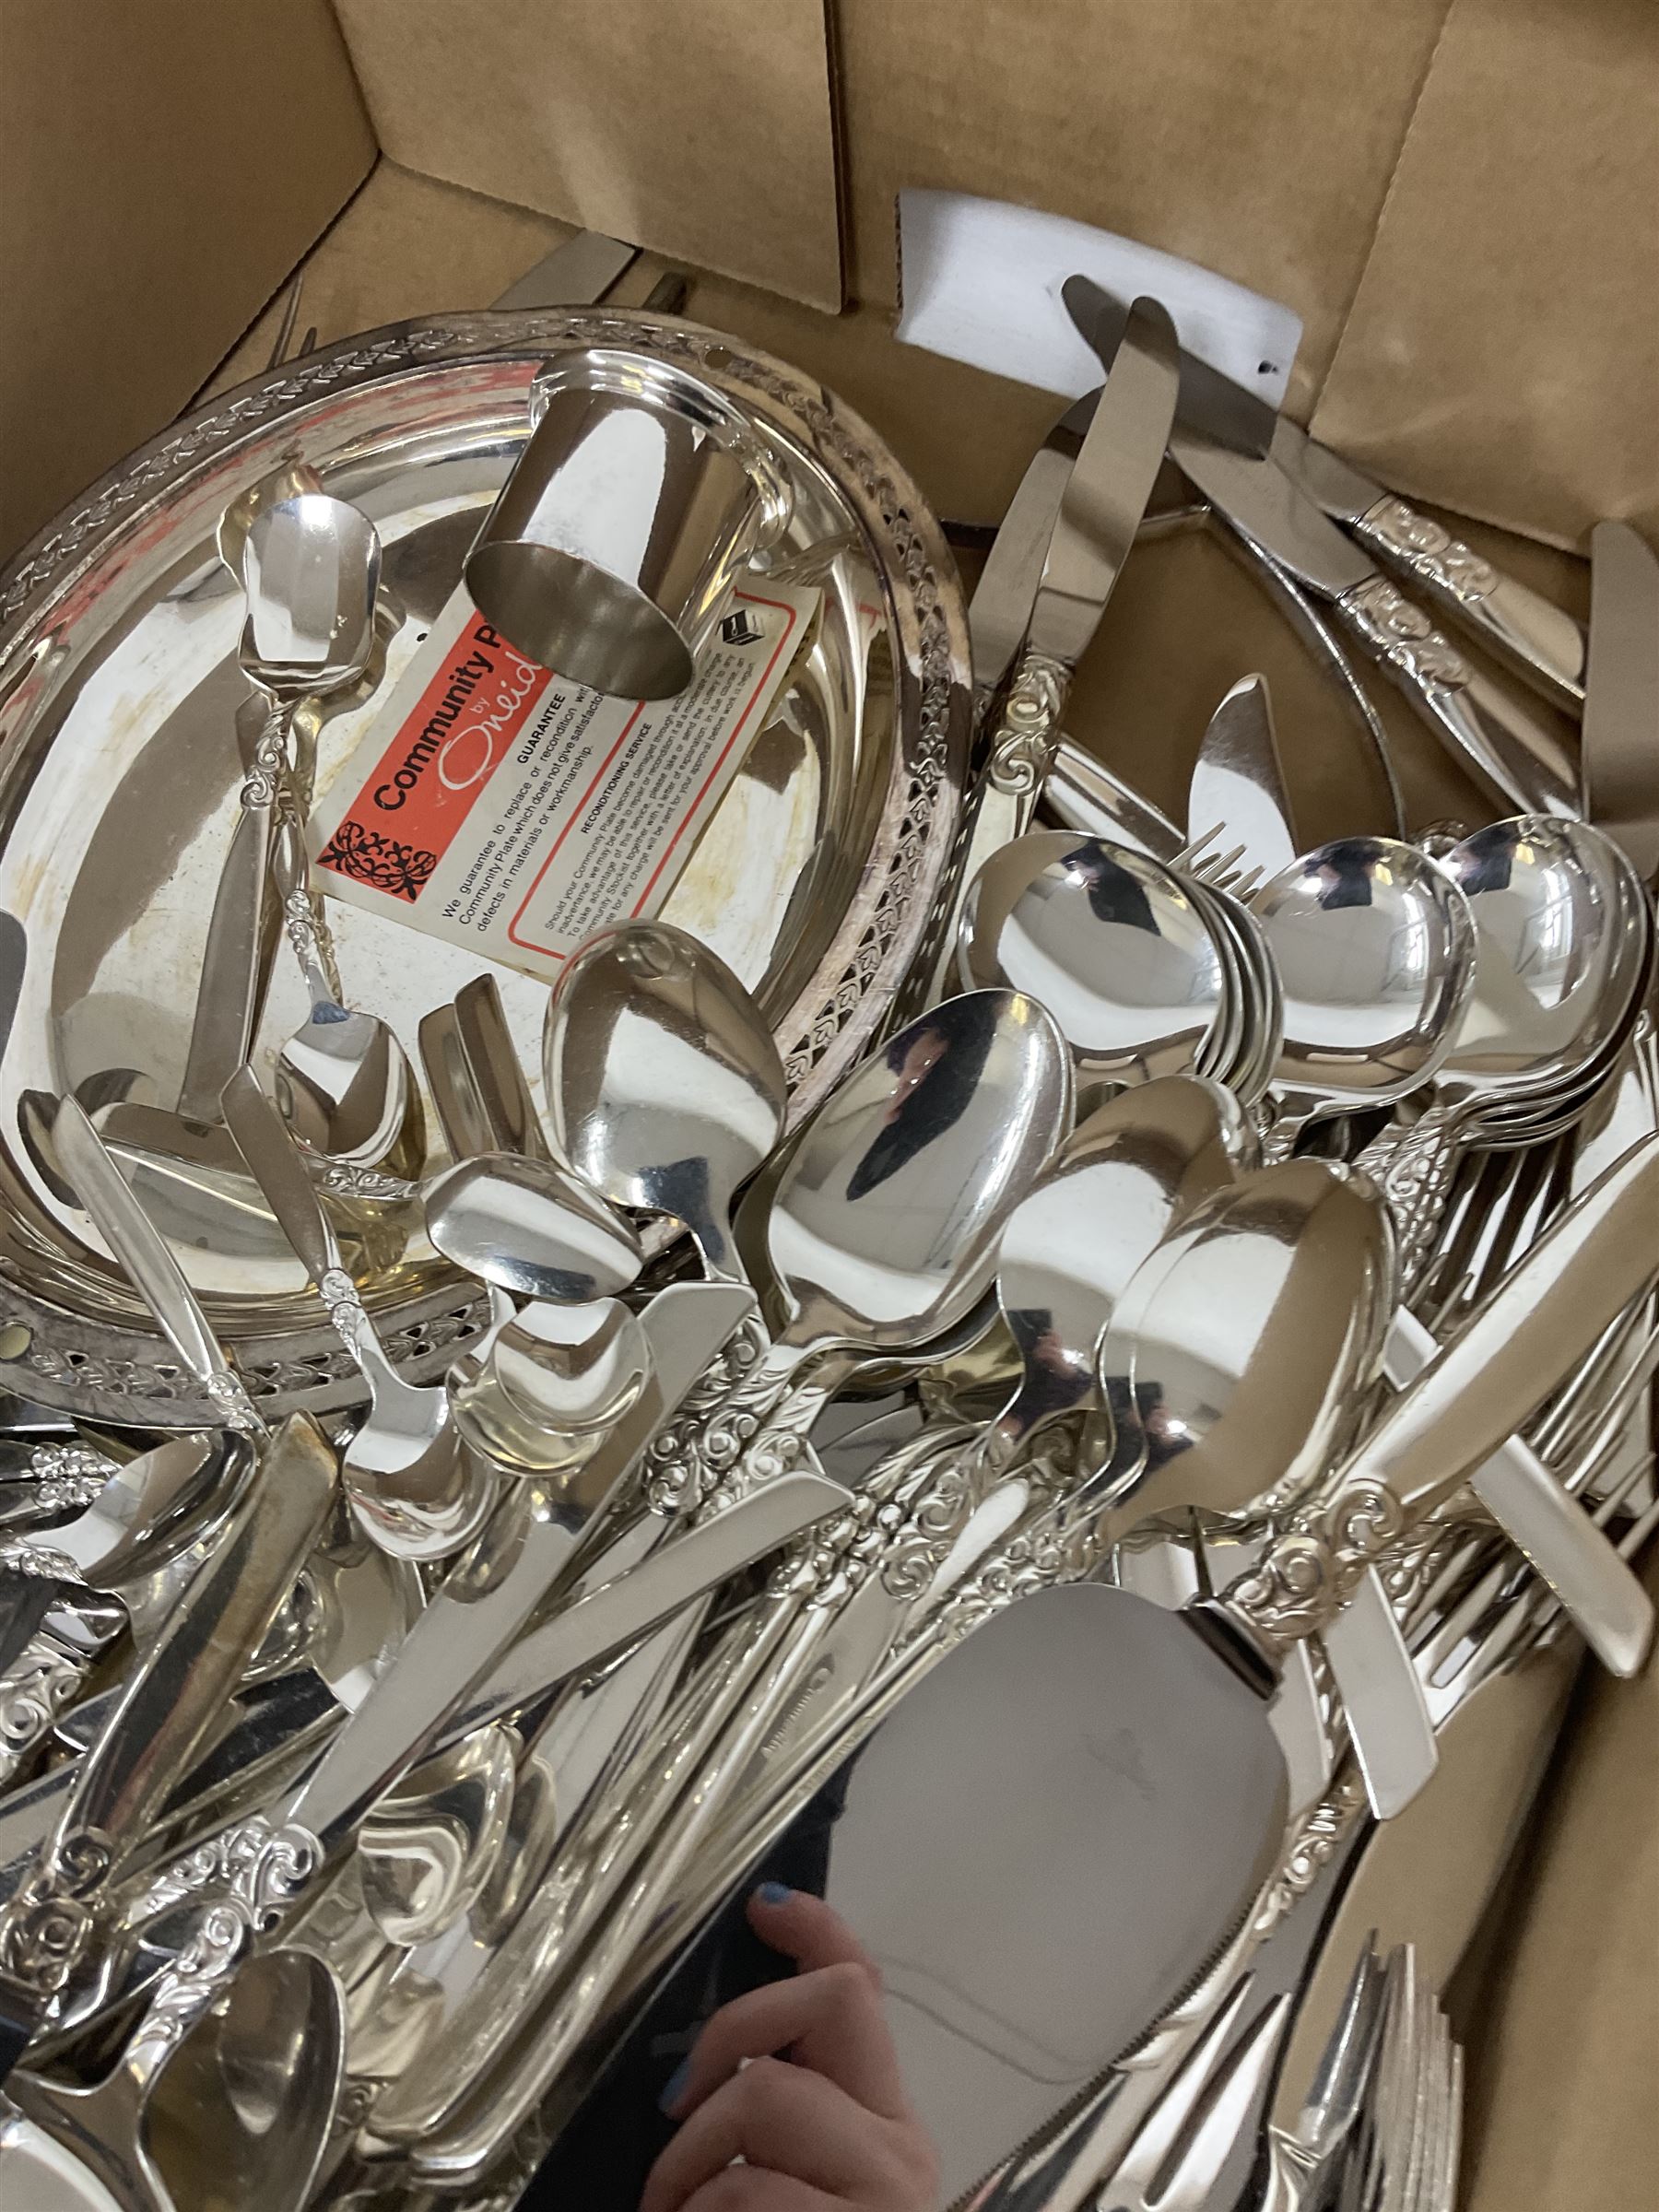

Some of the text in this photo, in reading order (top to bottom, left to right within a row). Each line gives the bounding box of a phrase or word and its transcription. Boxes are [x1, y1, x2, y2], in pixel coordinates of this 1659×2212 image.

[373, 650, 495, 811] Community
[437, 651, 542, 791] Oneid
[469, 697, 490, 714] by
[516, 693, 567, 764] GUARANTEE
[580, 723, 653, 834] RECONDITIONING SERVICE
[441, 899, 462, 918] We
[459, 840, 497, 895] guarantee
[503, 782, 533, 819] replace
[539, 707, 578, 762] recondition
[458, 863, 503, 925] Community
[493, 835, 518, 863] Plate
[512, 805, 537, 835] which
[531, 780, 553, 806] does
[547, 762, 564, 781] not
[557, 741, 576, 764] give
[477, 891, 506, 932] defects
[508, 827, 543, 877] materials
[546, 745, 594, 811] workmanship.
[544, 714, 676, 930] Should your Community Plate become damaged through
[575, 906, 593, 924] take
[589, 861, 618, 904] advantage
[618, 832, 633, 848] this
[648, 772, 668, 800] please
[663, 754, 678, 771] take
[681, 721, 698, 742] send
[692, 707, 705, 720] the
[588, 865, 601, 879] we
[595, 846, 612, 866] may
[613, 818, 628, 835] able
[629, 785, 646, 809] repair
[647, 735, 676, 776] recondition
[606, 862, 631, 896] Stockist
[625, 827, 649, 861] together
[646, 810, 660, 826] with
[659, 781, 677, 802] letter
[611, 898, 624, 912] for
[620, 881, 635, 898] any
[629, 852, 650, 881] charge
[661, 806, 677, 825] sent
[669, 794, 682, 806] for
[678, 775, 693, 794] your
[688, 741, 712, 776] approval
[707, 716, 726, 742] before
[723, 696, 738, 715] work
